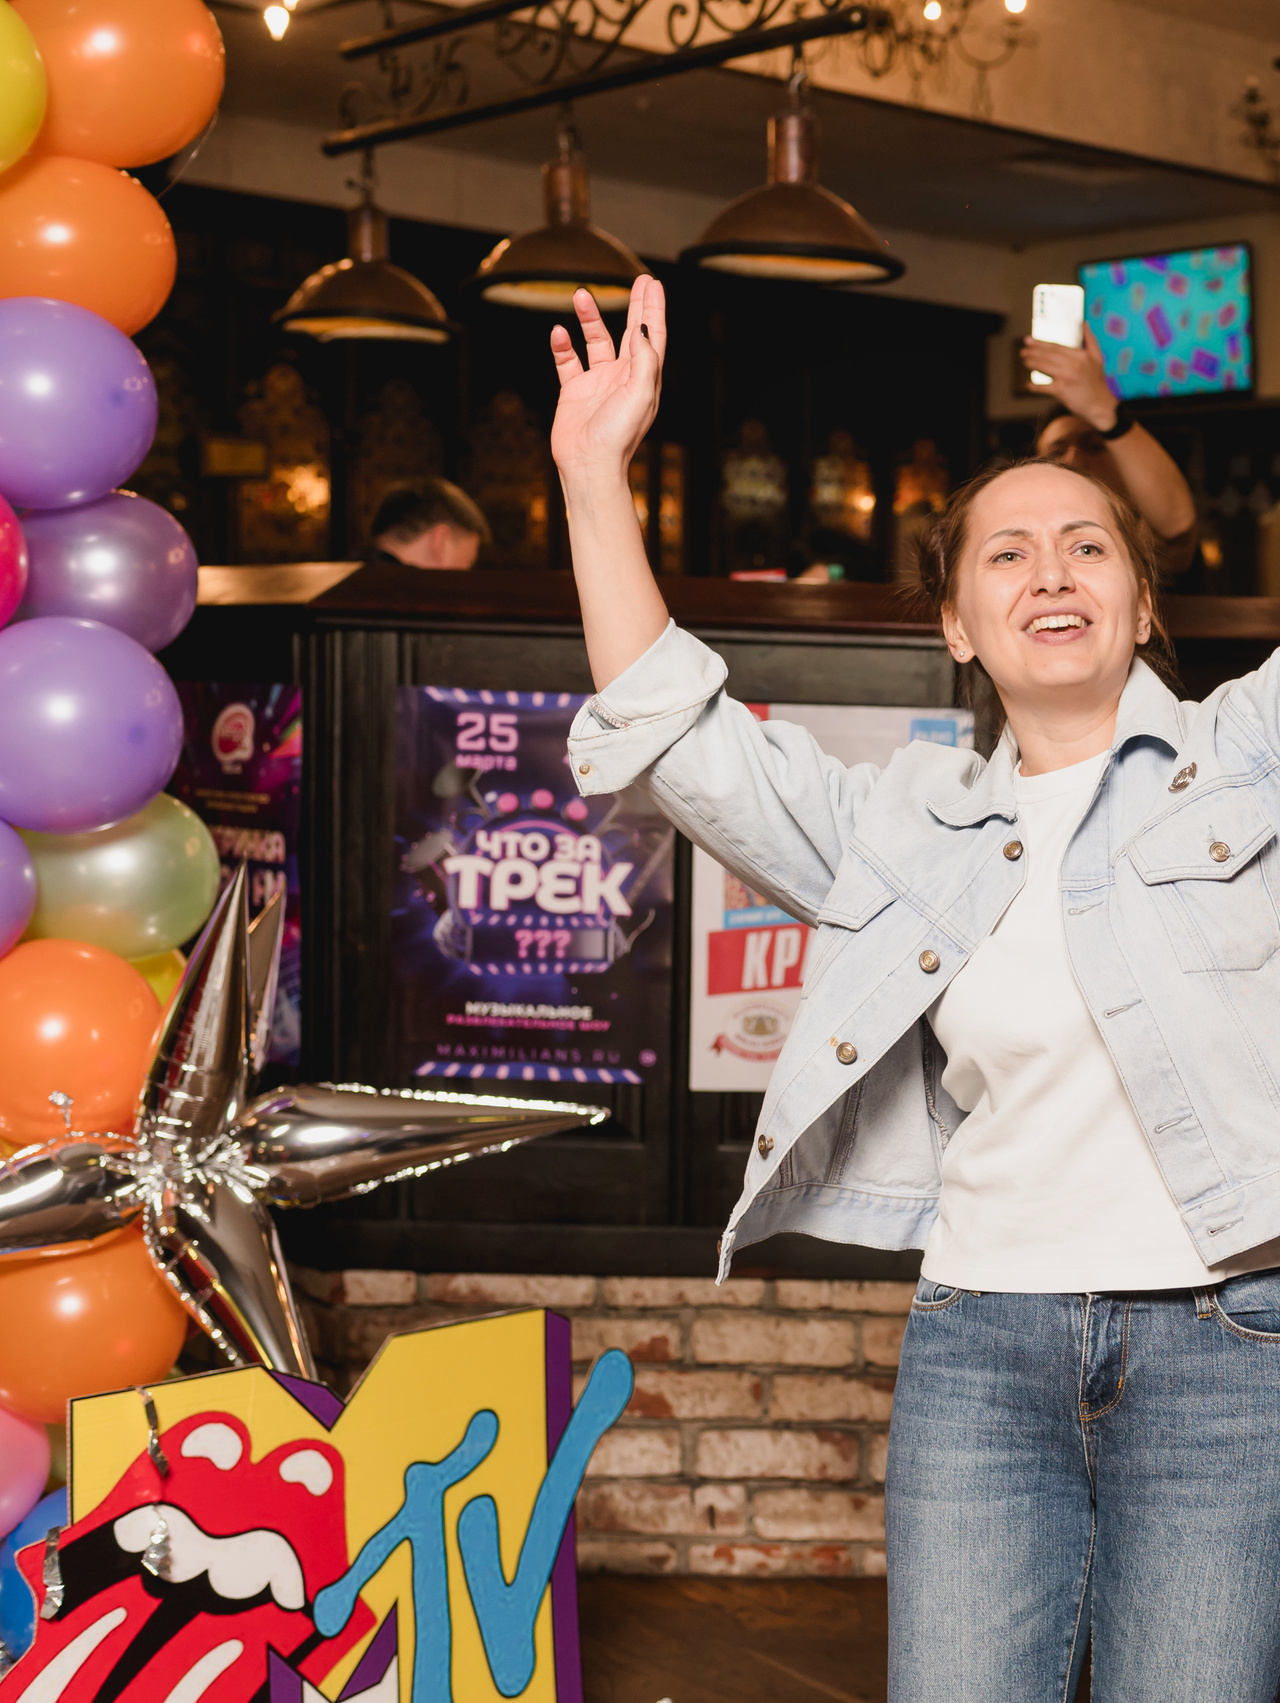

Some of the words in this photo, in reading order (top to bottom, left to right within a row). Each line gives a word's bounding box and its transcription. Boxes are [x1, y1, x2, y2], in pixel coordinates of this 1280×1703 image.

[456, 712, 519, 752] 25
[455, 754, 517, 773] марта
[476, 830, 550, 863] ЧТО
[553, 833, 602, 862] ЗА
[443, 855, 635, 917] ТРЕК
[465, 1001, 593, 1021] МУЗЫКАЛЬНОЕ
[437, 1043, 621, 1065] MAXIMILIANS.RU
